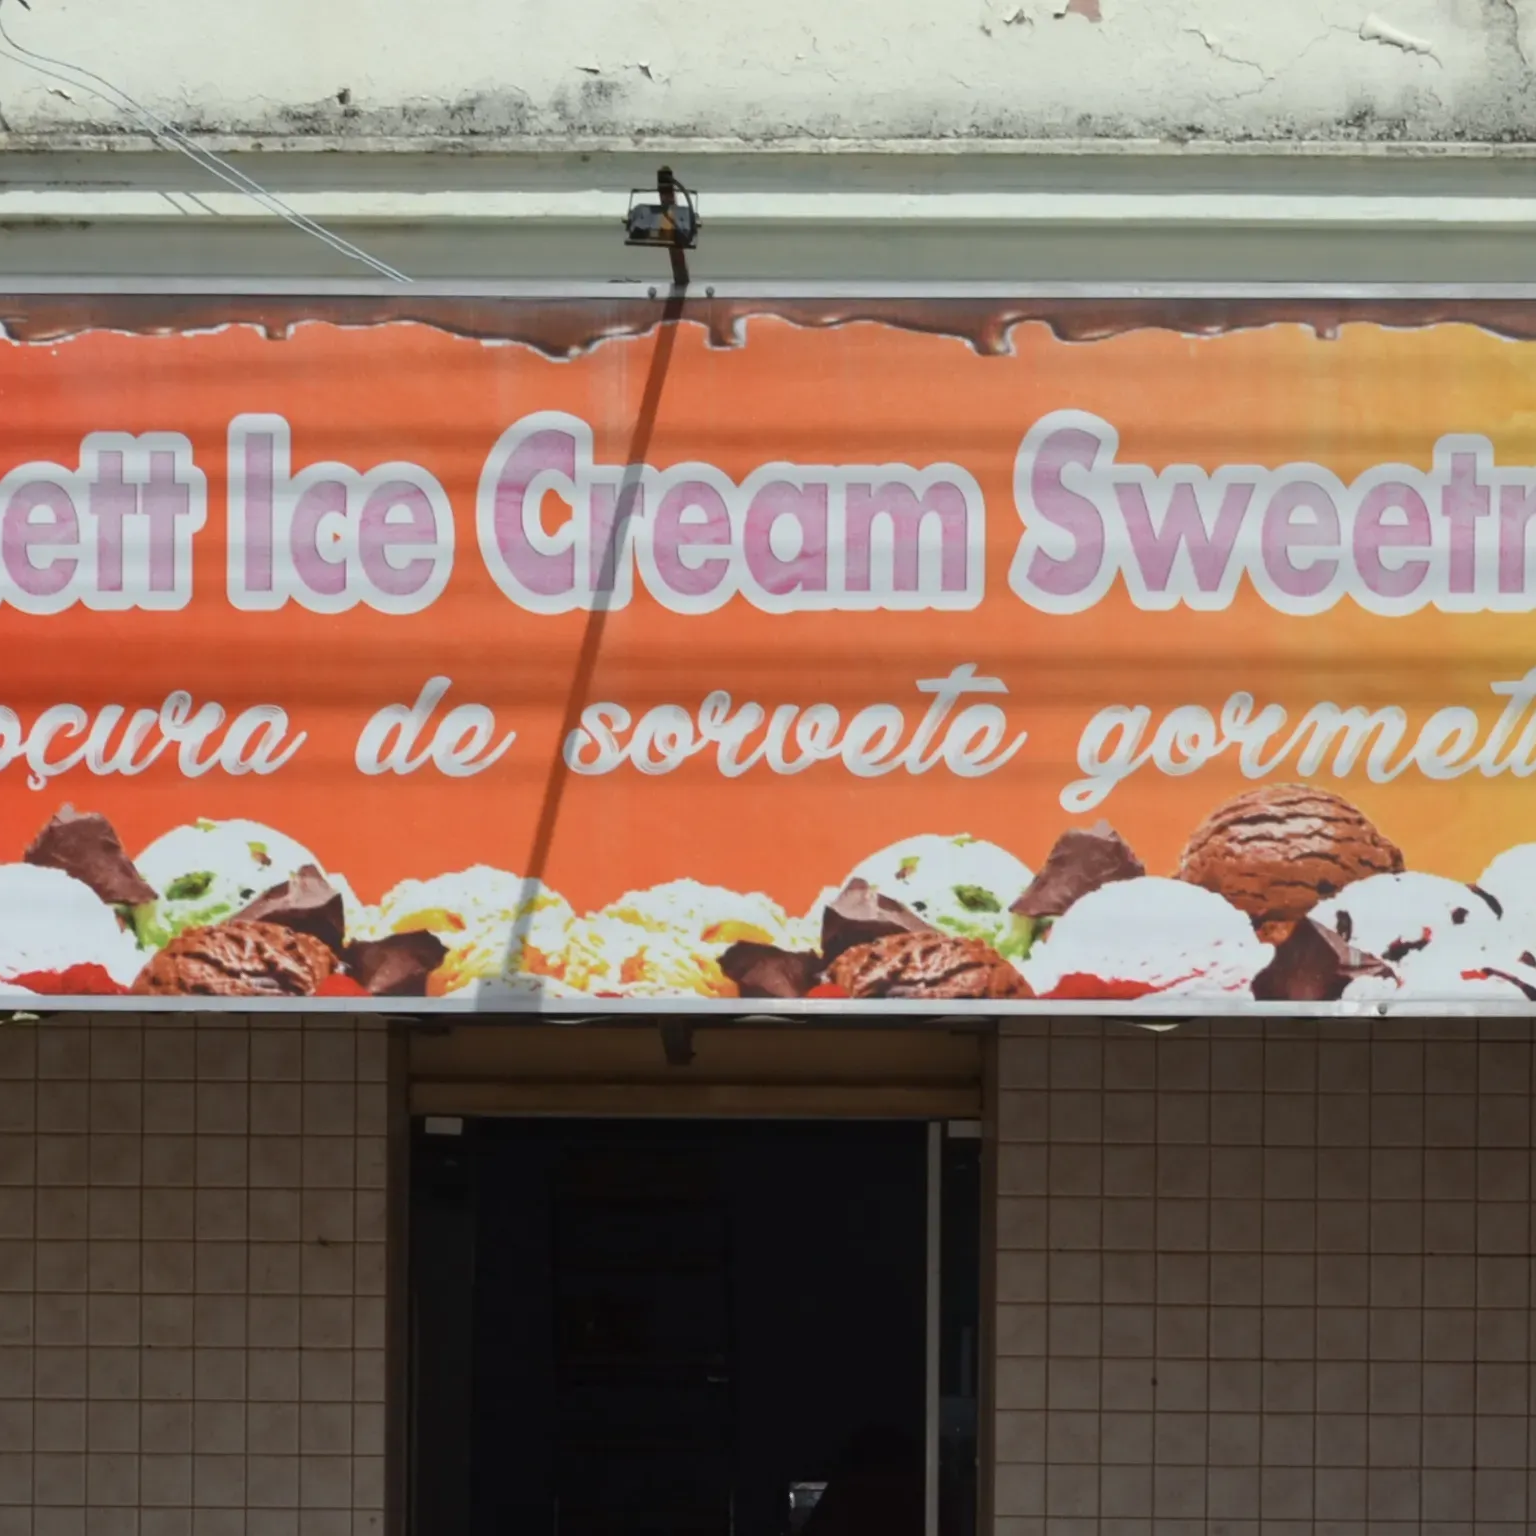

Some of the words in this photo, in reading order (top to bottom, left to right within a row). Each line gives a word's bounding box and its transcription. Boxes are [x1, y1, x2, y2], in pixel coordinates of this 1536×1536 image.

[226, 411, 454, 616] Ice
[476, 409, 985, 616] Cream
[355, 675, 517, 778] de
[562, 663, 1027, 778] sorvete
